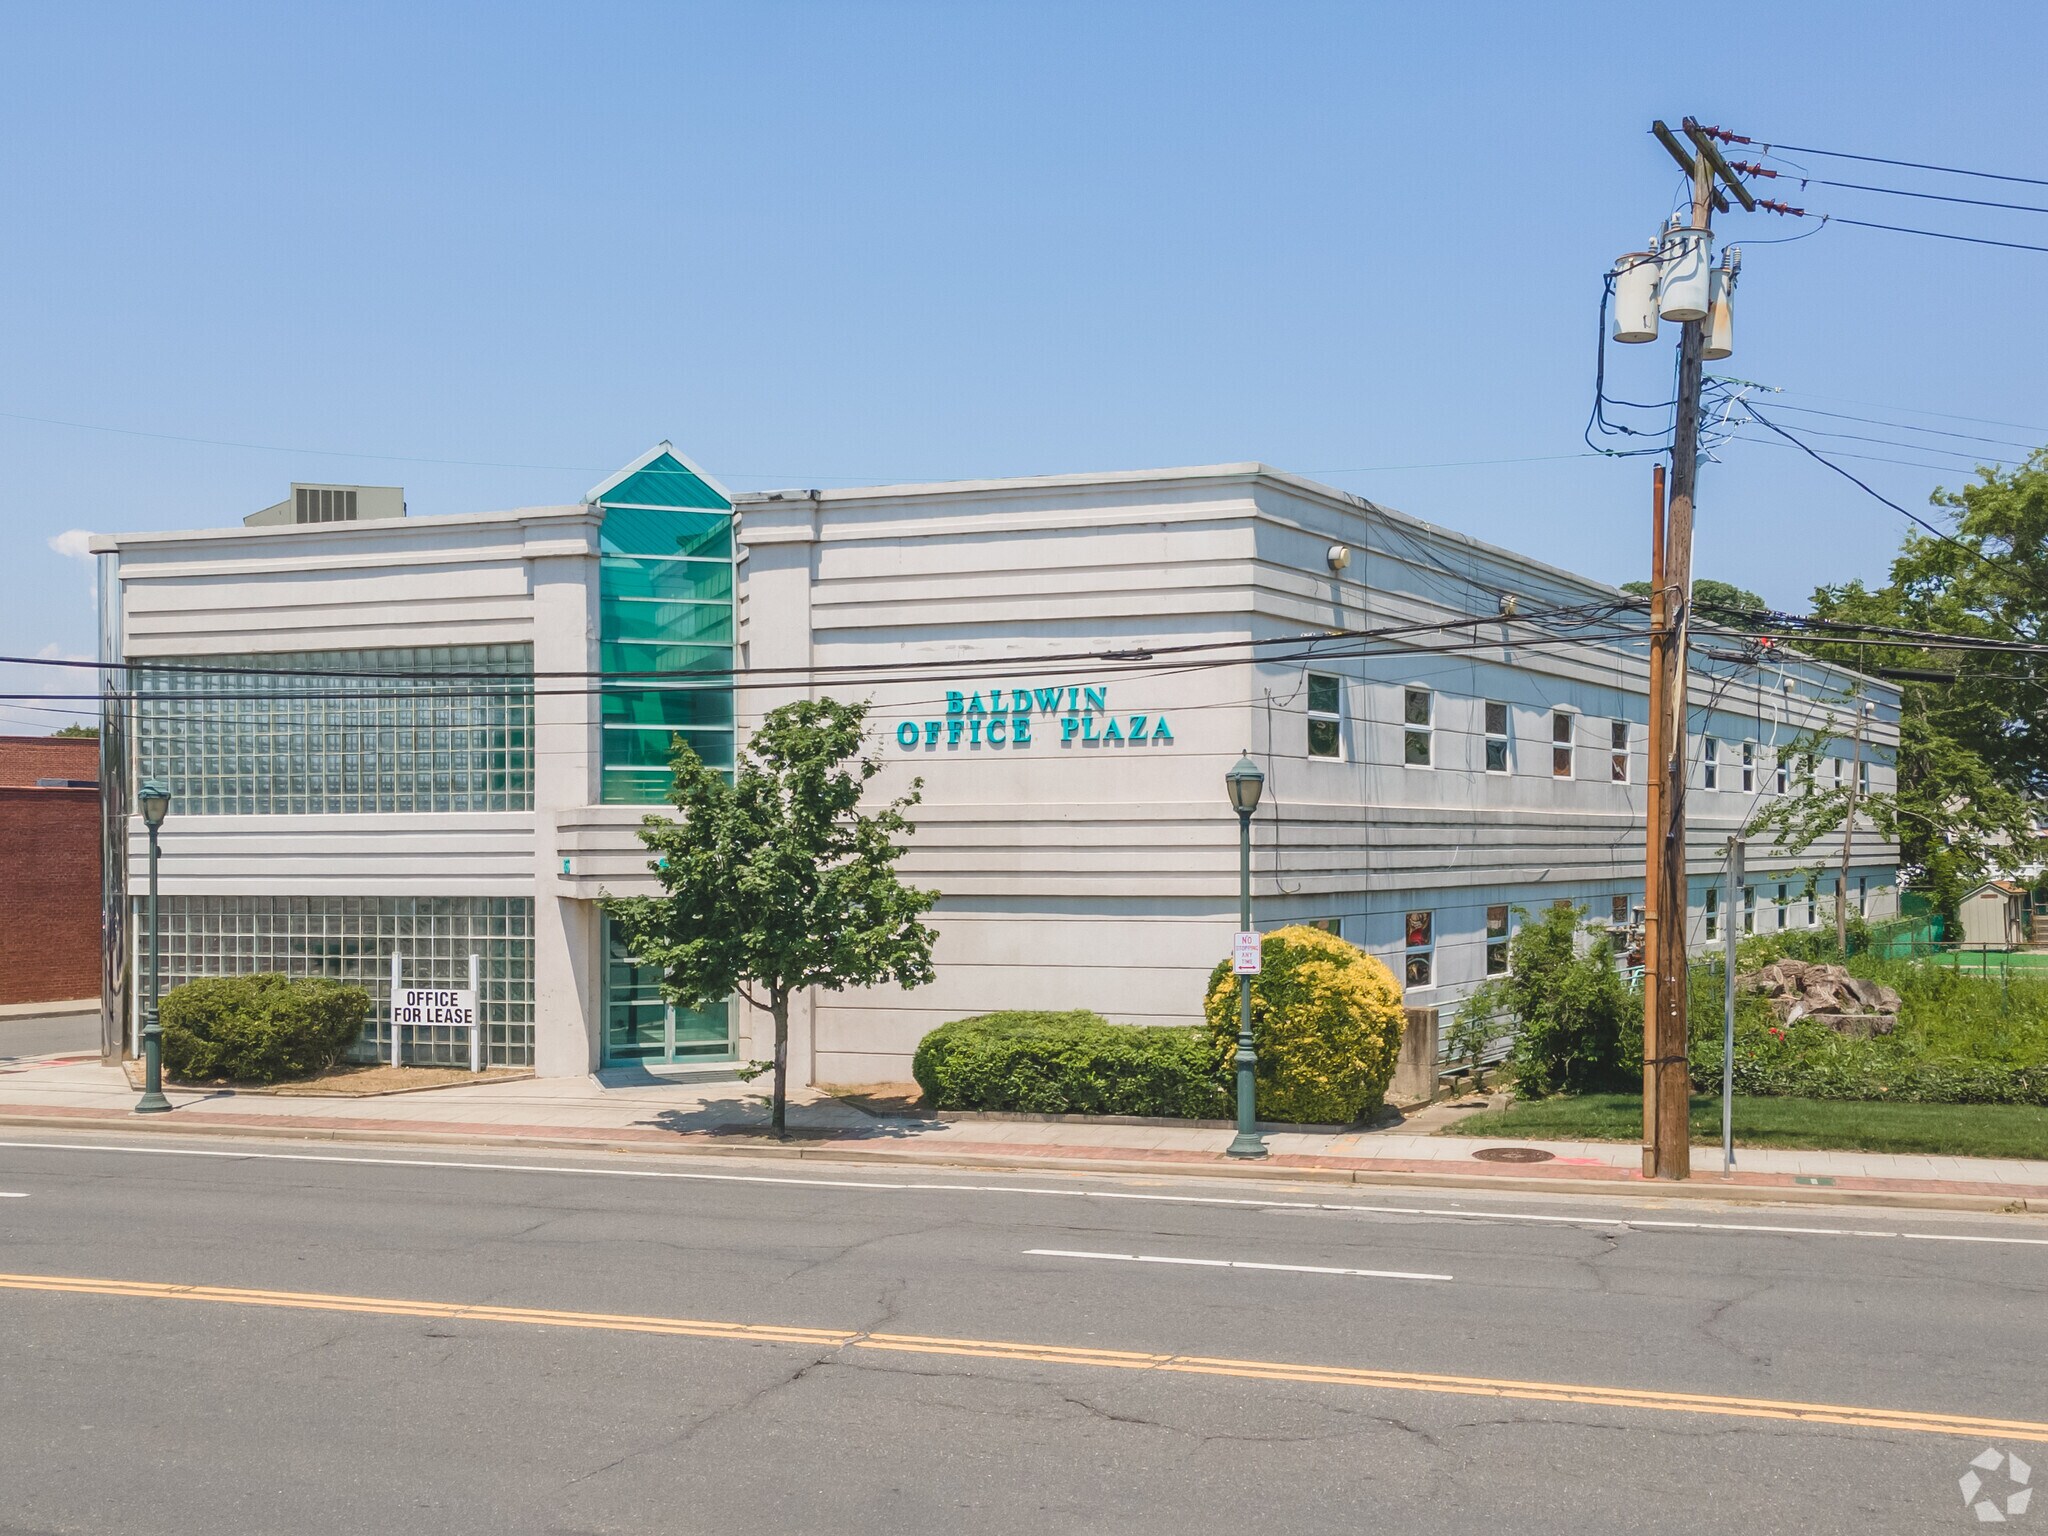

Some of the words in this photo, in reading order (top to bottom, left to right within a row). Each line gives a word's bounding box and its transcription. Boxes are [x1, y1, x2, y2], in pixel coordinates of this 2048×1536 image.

[946, 687, 1106, 714] BALDWIN
[897, 718, 1032, 745] OFFICE
[1061, 714, 1174, 741] PLAZA
[1241, 936, 1252, 944] NO
[407, 991, 458, 1006] OFFICE
[394, 1007, 421, 1022] FOR
[427, 1008, 472, 1023] LEASE
